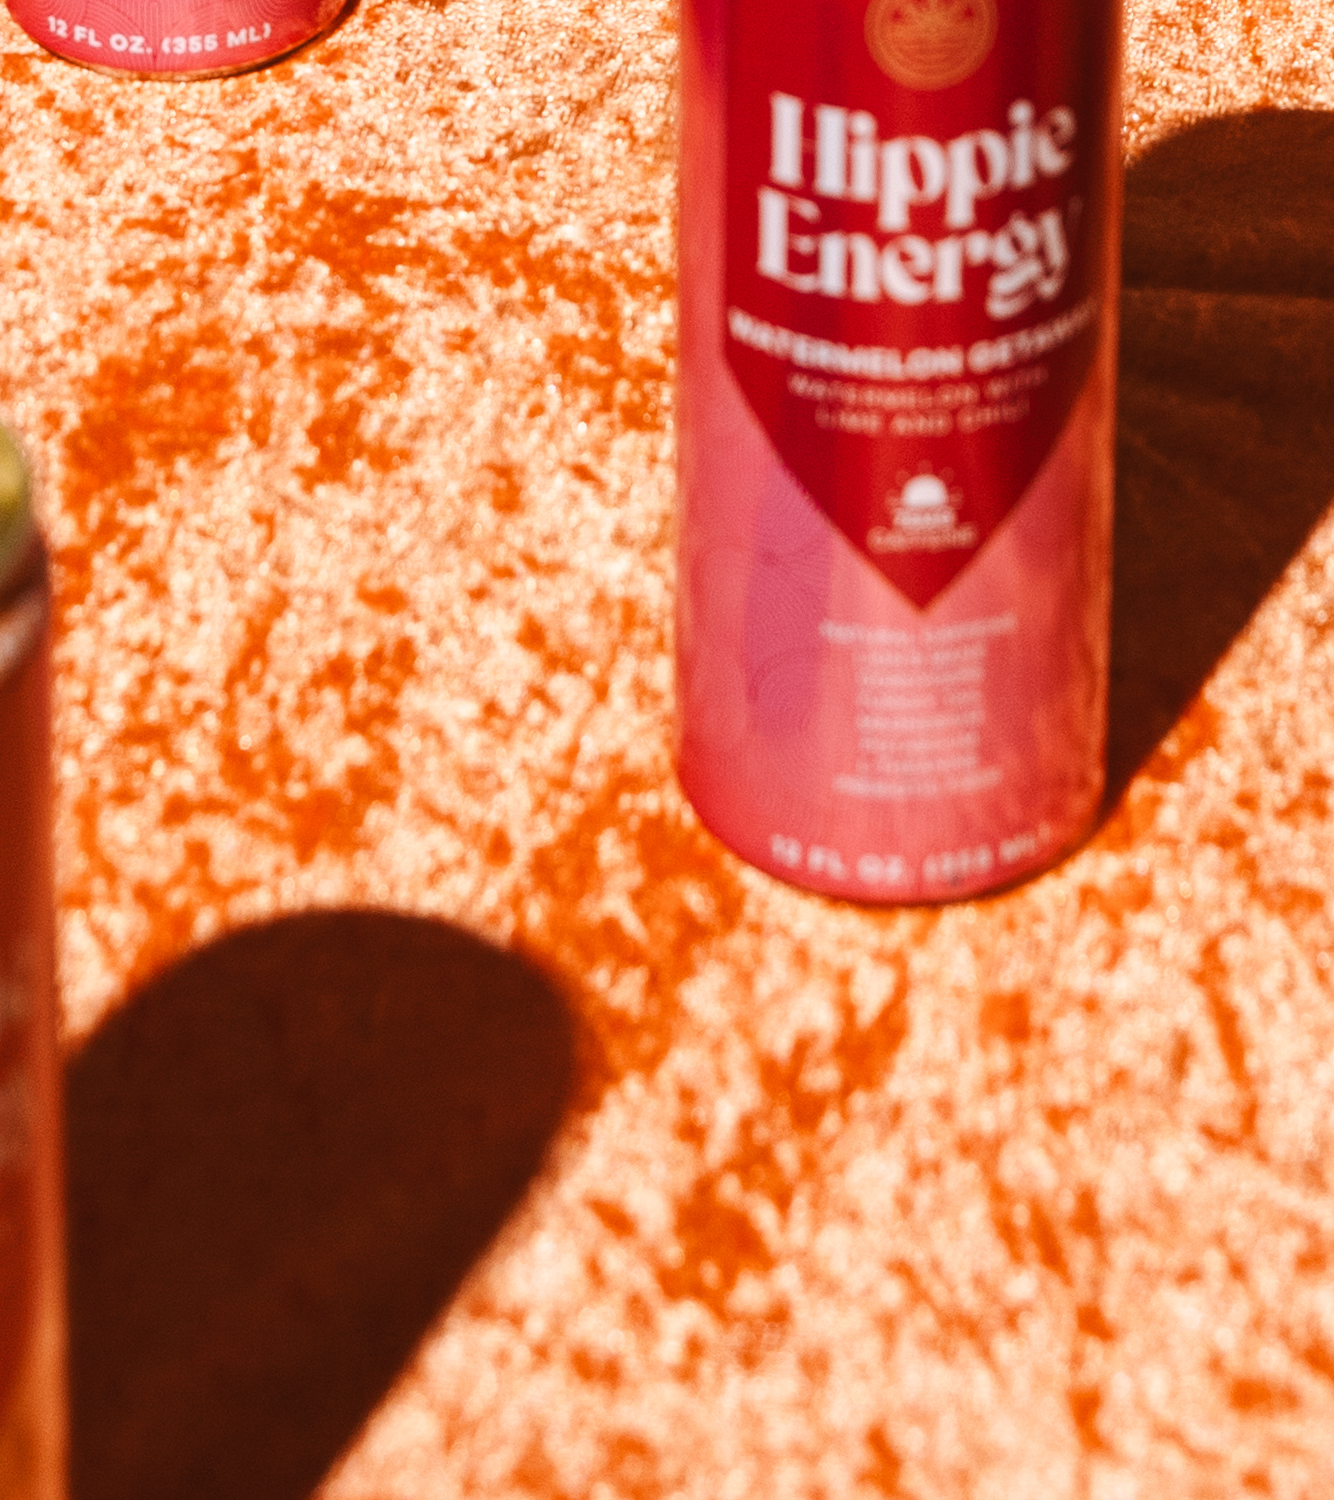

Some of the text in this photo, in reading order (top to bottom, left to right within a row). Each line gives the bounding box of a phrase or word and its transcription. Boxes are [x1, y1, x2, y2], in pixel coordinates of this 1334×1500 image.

[47, 14, 271, 54] 12 FL OZ. (355 ML)
[770, 91, 1075, 232] Hippie
[758, 184, 1077, 320] Energy
